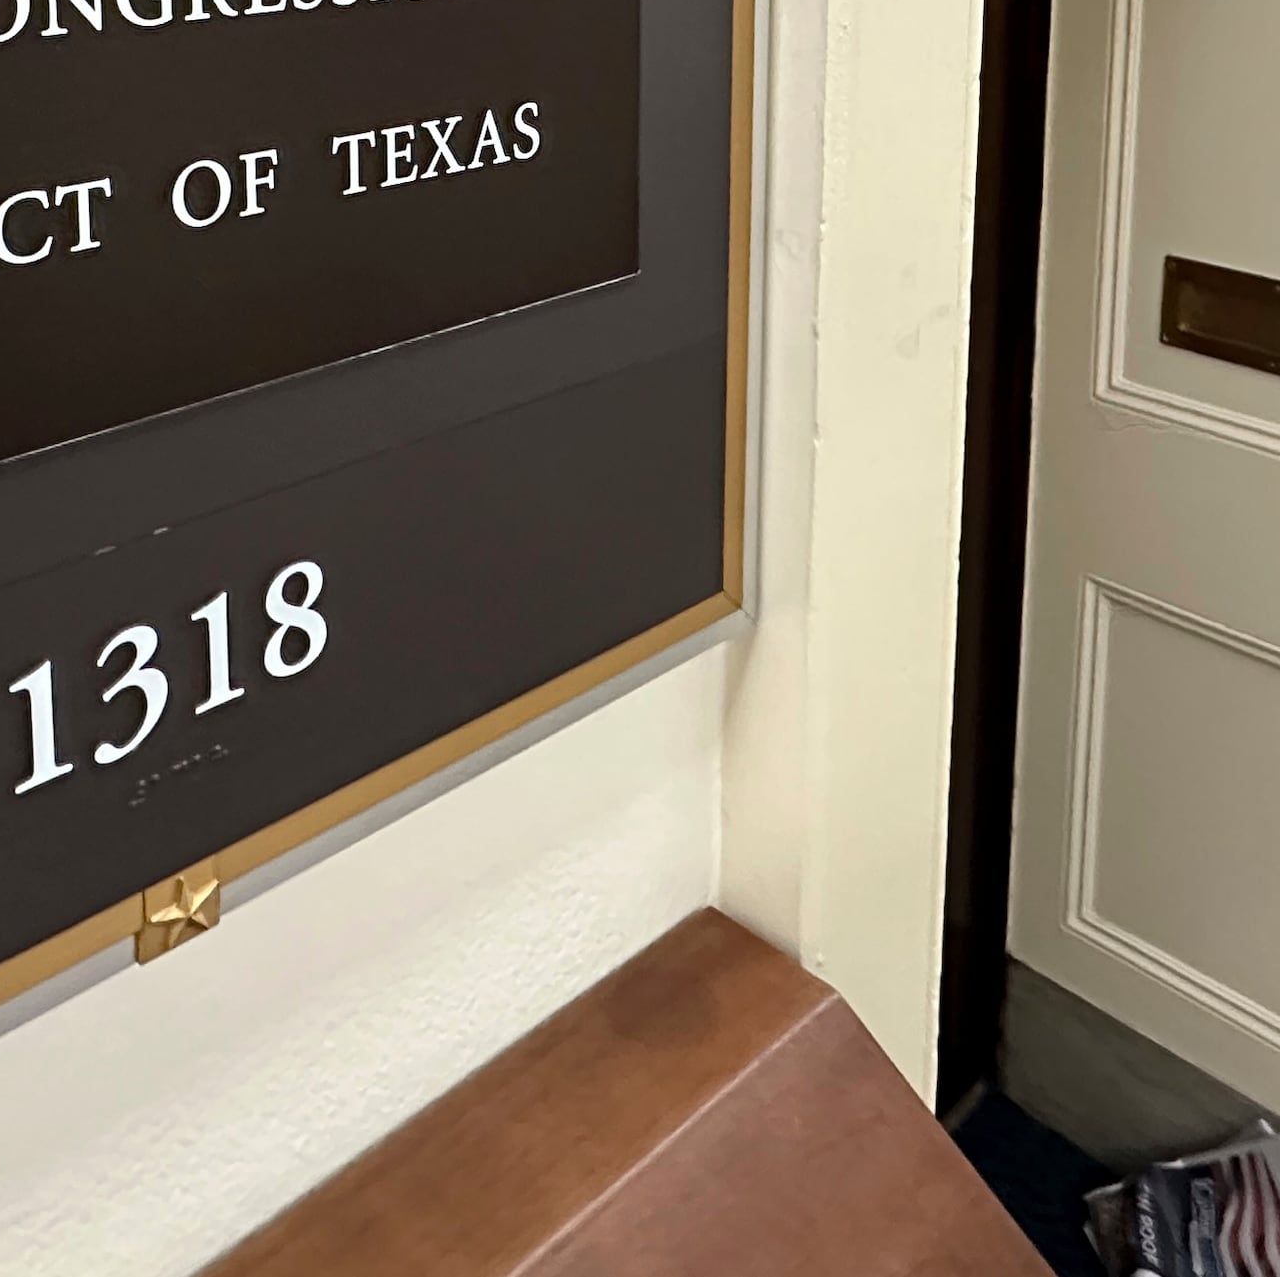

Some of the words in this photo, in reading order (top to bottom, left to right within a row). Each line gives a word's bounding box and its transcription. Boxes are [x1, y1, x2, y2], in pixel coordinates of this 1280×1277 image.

[170, 147, 279, 229] OF
[330, 101, 541, 197] TEXAS
[7, 560, 329, 796] 1318
